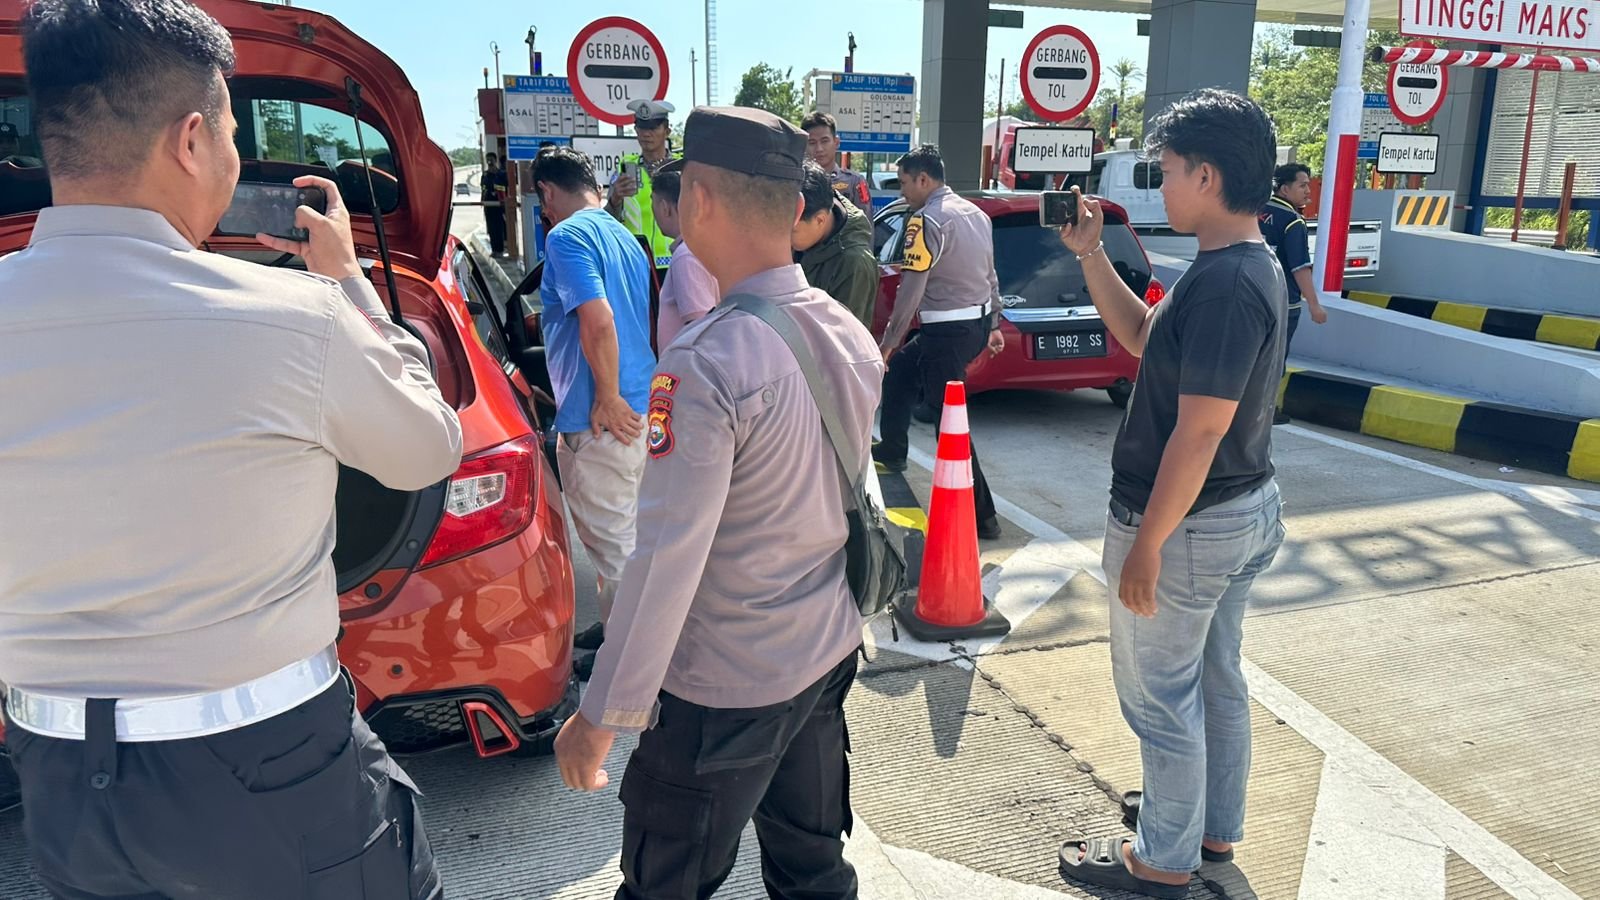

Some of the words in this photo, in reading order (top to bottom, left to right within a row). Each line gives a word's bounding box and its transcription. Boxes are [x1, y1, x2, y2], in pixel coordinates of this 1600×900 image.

[1517, 2, 1588, 39] MAKS
[586, 43, 650, 61] GERBANG
[1036, 48, 1087, 64] GERBANG
[1400, 63, 1438, 75] GERBANG
[519, 77, 543, 87] TARIF
[545, 79, 560, 88] TOL
[844, 75, 865, 84] TARIF
[868, 76, 881, 85] TOL
[606, 84, 631, 100] TOL
[870, 93, 906, 101] GOLONGAN
[1048, 83, 1066, 98] TOL
[1408, 92, 1422, 105] TOL
[508, 107, 534, 118] ASAL
[838, 107, 857, 116] ASAL
[1019, 142, 1058, 161] Tempel
[1062, 143, 1091, 158] Kartu
[1381, 146, 1410, 163] Tempel
[1413, 147, 1435, 161] Kartu
[1038, 336, 1046, 349] E
[1056, 335, 1079, 348] 1982
[1089, 333, 1102, 346] SS
